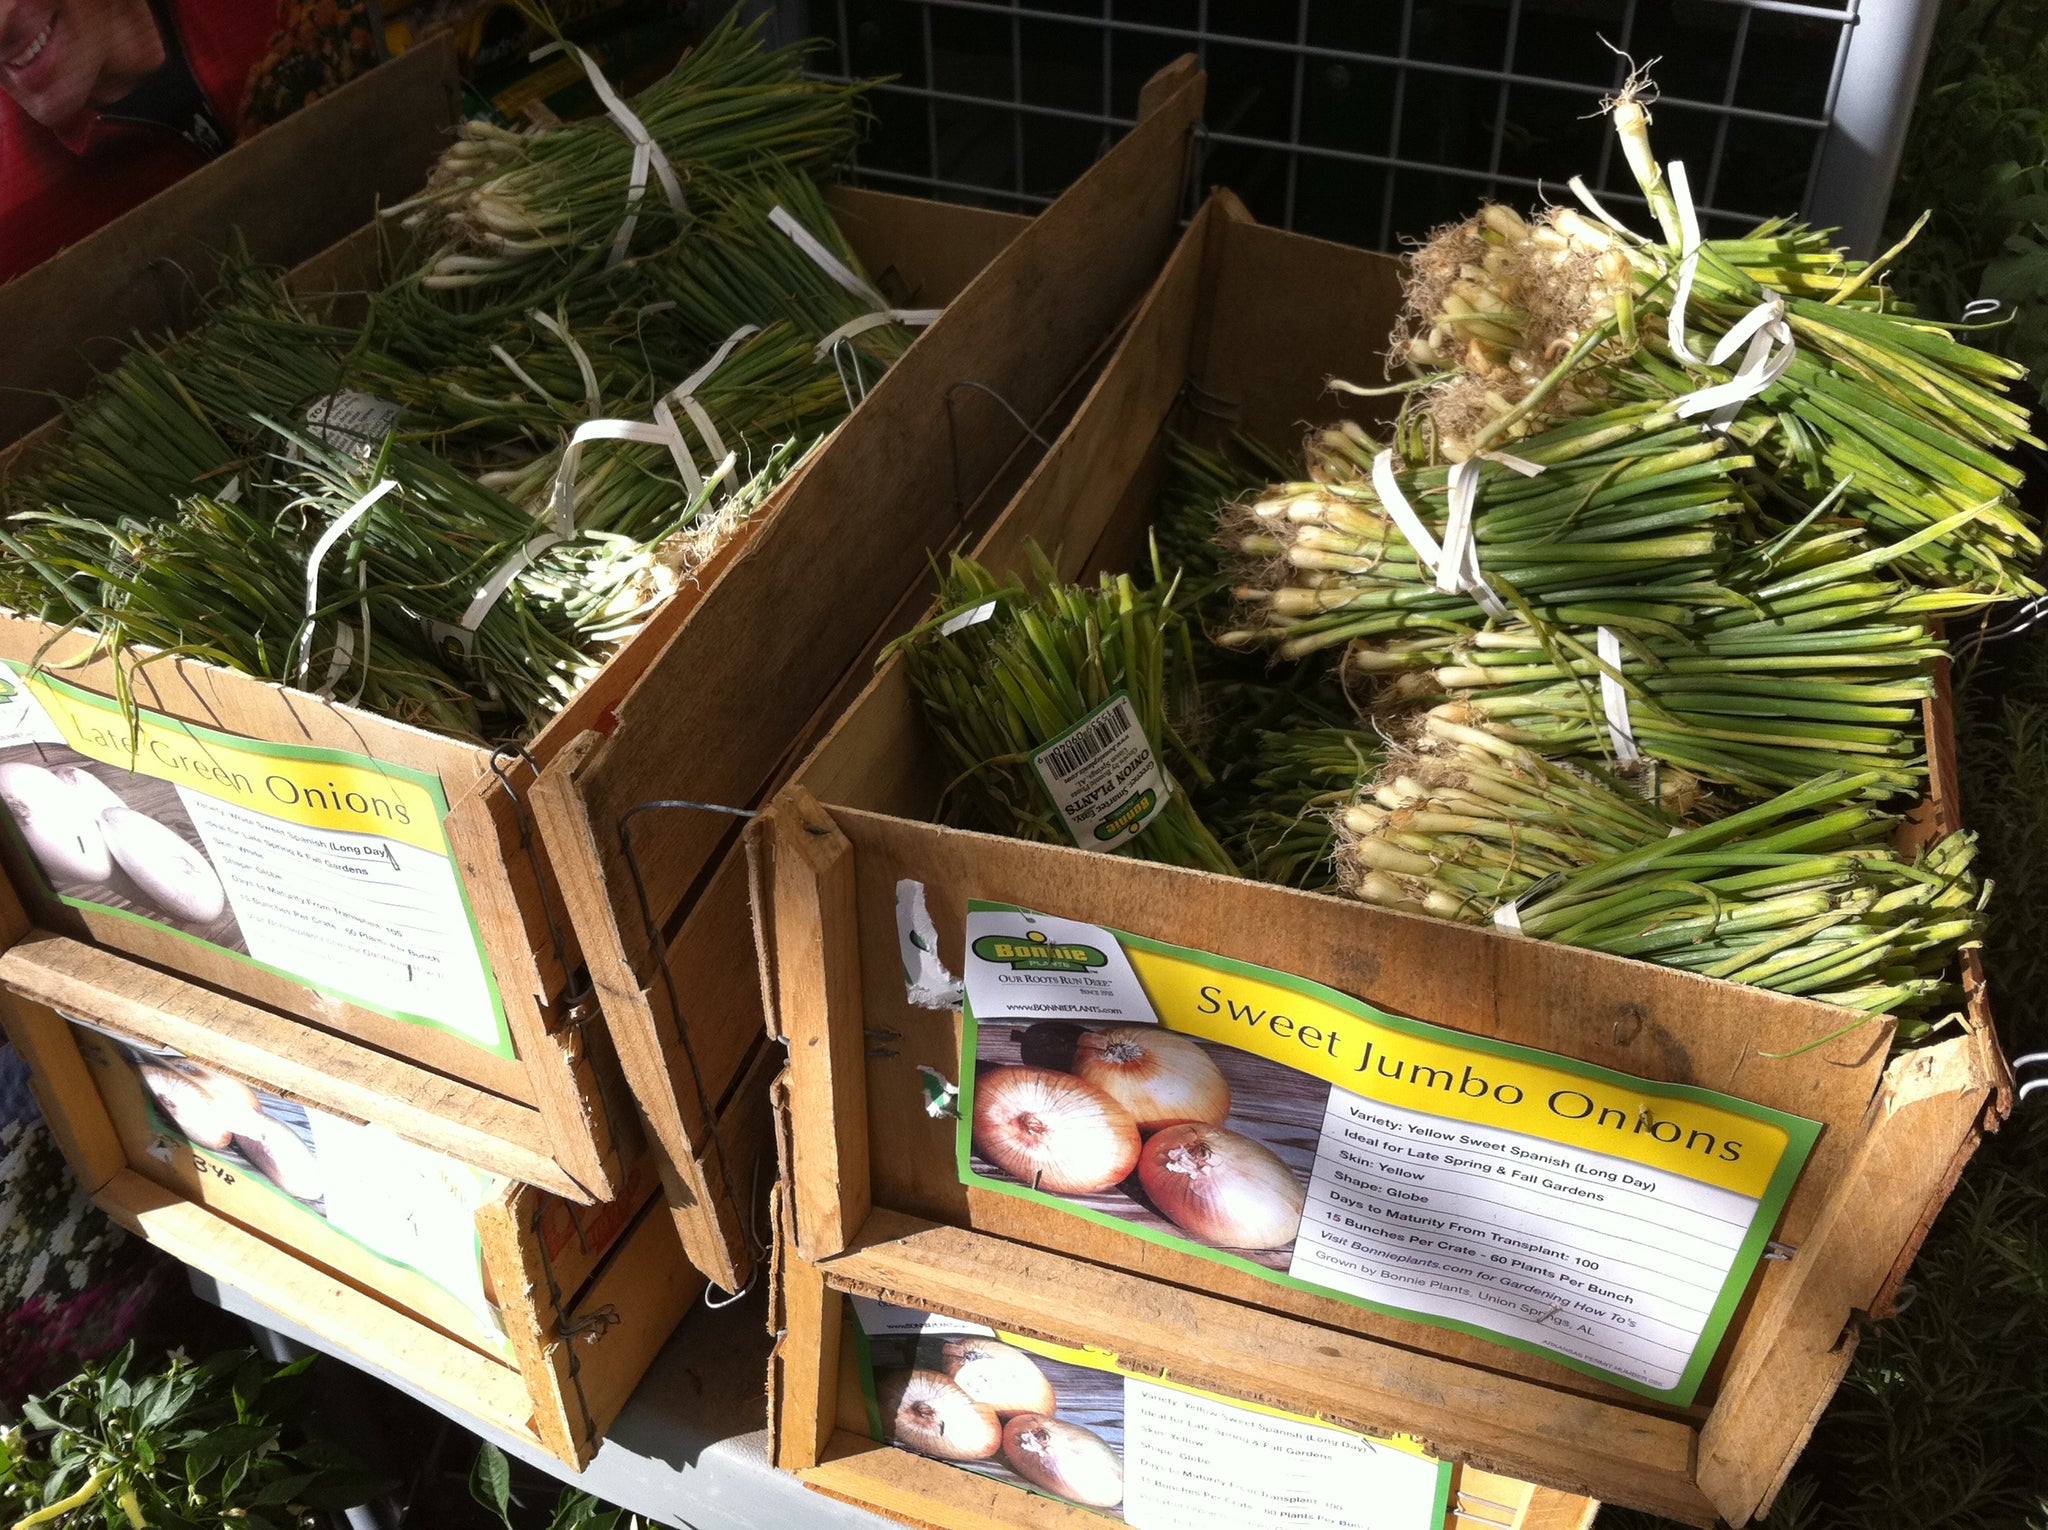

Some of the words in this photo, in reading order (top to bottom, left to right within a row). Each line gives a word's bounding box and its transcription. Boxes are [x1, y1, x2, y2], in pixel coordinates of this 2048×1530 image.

[71, 713, 139, 756] Late
[151, 740, 254, 795] Green
[267, 775, 411, 826] Onions
[1115, 749, 1149, 784] ONION
[1064, 781, 1116, 816] PLANTS
[329, 841, 361, 856] (Long
[324, 859, 369, 876] Gardens
[994, 943, 1088, 962] Bonnie
[1196, 985, 1342, 1058] Sweet
[1355, 1042, 1525, 1106] Jumbo
[1548, 1089, 1744, 1163] Onions
[1338, 1150, 1374, 1168] Skin:
[1378, 1162, 1426, 1181] Yellow
[1344, 1128, 1379, 1148] Ideal
[1382, 1141, 1404, 1154] for
[1407, 1147, 1440, 1162] Late
[1443, 1155, 1492, 1174] Spring
[1496, 1166, 1507, 1176] &
[1511, 1170, 1538, 1184] Fall
[1542, 1178, 1605, 1202] Gardens
[1349, 1106, 1402, 1130] Variety:
[1407, 1124, 1455, 1141] Yellow
[1459, 1135, 1506, 1153] Sweet
[1510, 1146, 1570, 1169] Spanish
[1574, 1162, 1618, 1182] (Long
[1621, 1174, 1657, 1193] Day)
[1333, 1170, 1383, 1193] Shape:
[1386, 1187, 1430, 1204] Globe
[1330, 1190, 1364, 1211] Days
[1368, 1204, 1382, 1215] to
[1386, 1209, 1446, 1230] Maturity
[1449, 1222, 1486, 1239] From
[1490, 1231, 1571, 1262] Transplant:
[1574, 1256, 1600, 1271] 100
[1326, 1211, 1342, 1223] 15
[1345, 1217, 1405, 1242] Bunches
[1409, 1235, 1435, 1249] Per
[1437, 1240, 1477, 1257] Crate
[1490, 1253, 1508, 1265] 60
[1511, 1259, 1556, 1280] Plants
[1558, 1273, 1585, 1289] Per
[1587, 1282, 1635, 1305] Bunch
[1315, 1250, 1358, 1270] Grown
[1361, 1262, 1377, 1276] by
[1380, 1270, 1427, 1287] Bonnie
[1477, 1290, 1516, 1309] Union
[1321, 1230, 1348, 1247] Visit
[1351, 1240, 1473, 1277] Bonnieplants.com
[1476, 1271, 1498, 1284] for
[1499, 1276, 1572, 1307] Gardening
[1574, 1300, 1607, 1317] How
[1610, 1312, 1638, 1328] To's
[1258, 1423, 1303, 1440] Spanish
[1306, 1433, 1339, 1447] (Long
[1341, 1441, 1367, 1454] Day)
[1286, 1447, 1333, 1461] Gardens
[1279, 1511, 1315, 1521] Plants
